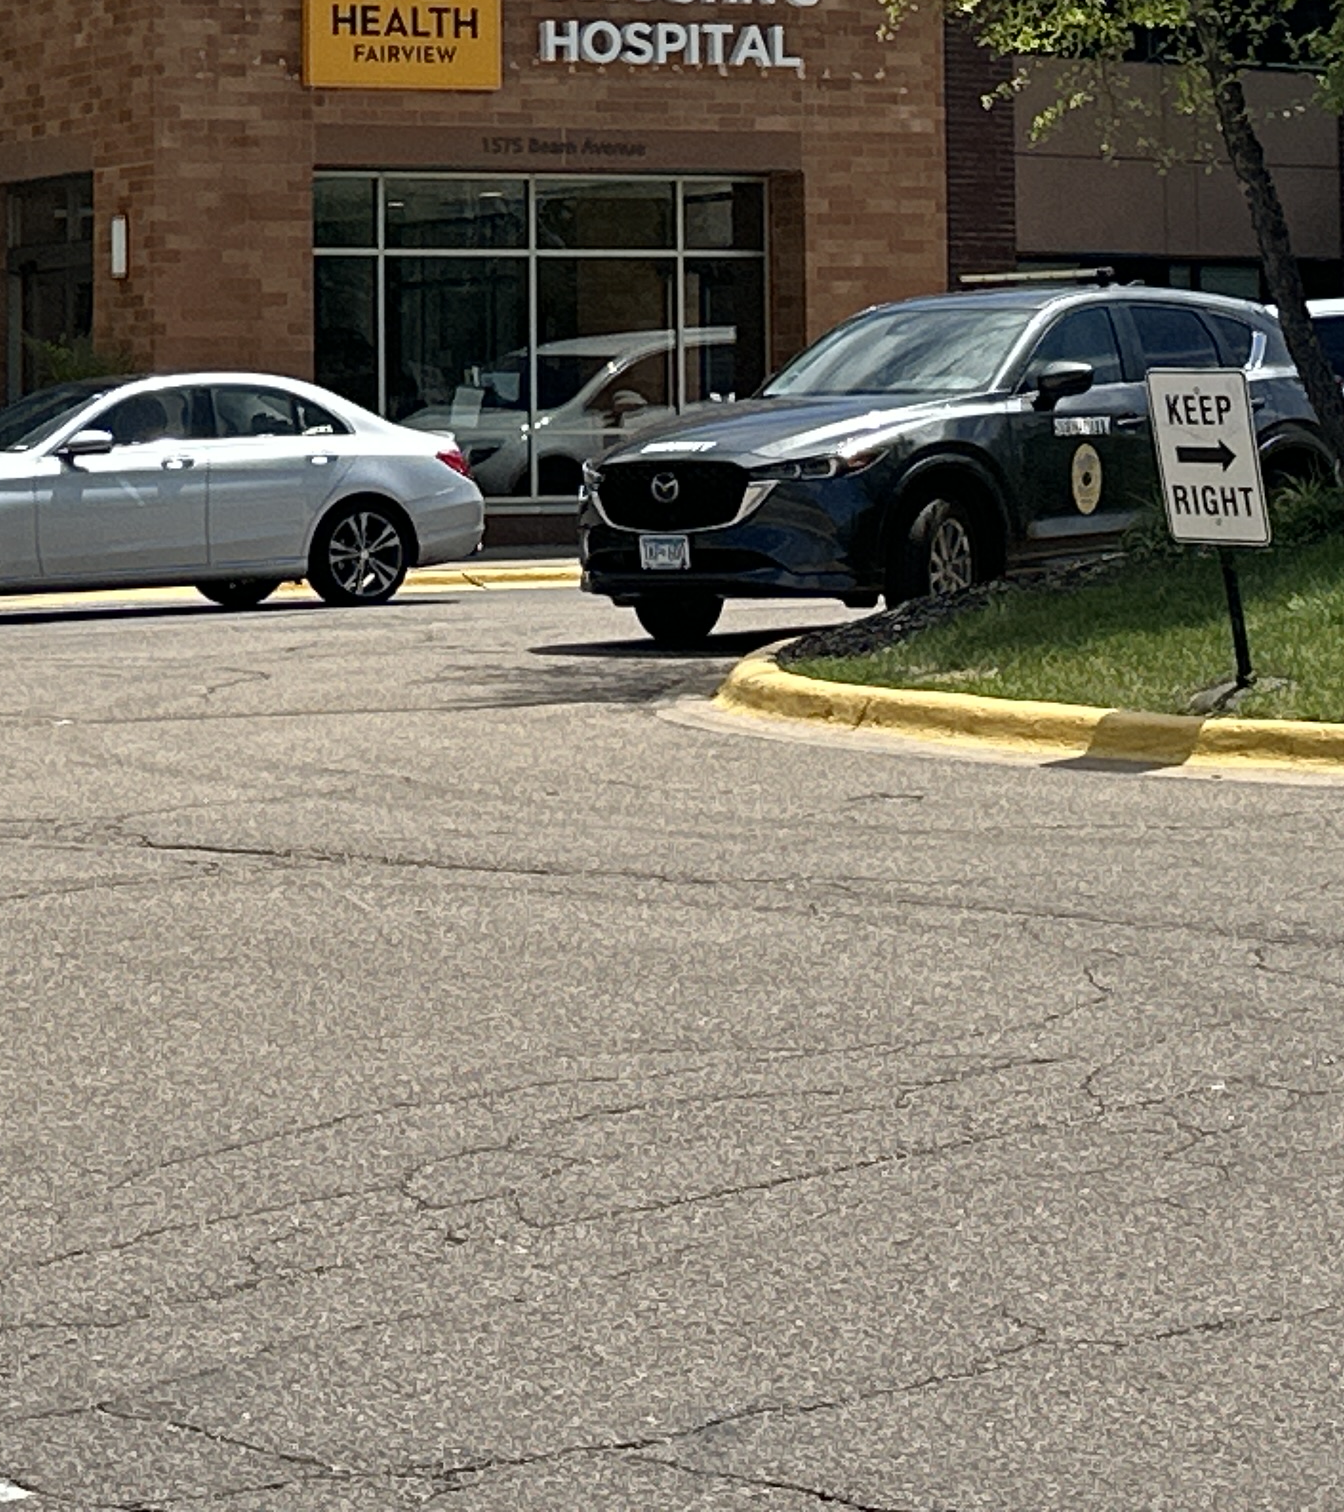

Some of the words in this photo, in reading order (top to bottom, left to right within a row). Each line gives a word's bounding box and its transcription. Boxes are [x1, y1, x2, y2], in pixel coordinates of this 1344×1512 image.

[332, 4, 478, 38] HEALTH
[353, 44, 457, 63] FAIRVIEW
[540, 20, 802, 67] HOSPITAL
[482, 137, 523, 153] 1575
[581, 138, 646, 157] Avenue
[1165, 394, 1231, 425] KEEP
[1172, 485, 1253, 517] RIGHT
